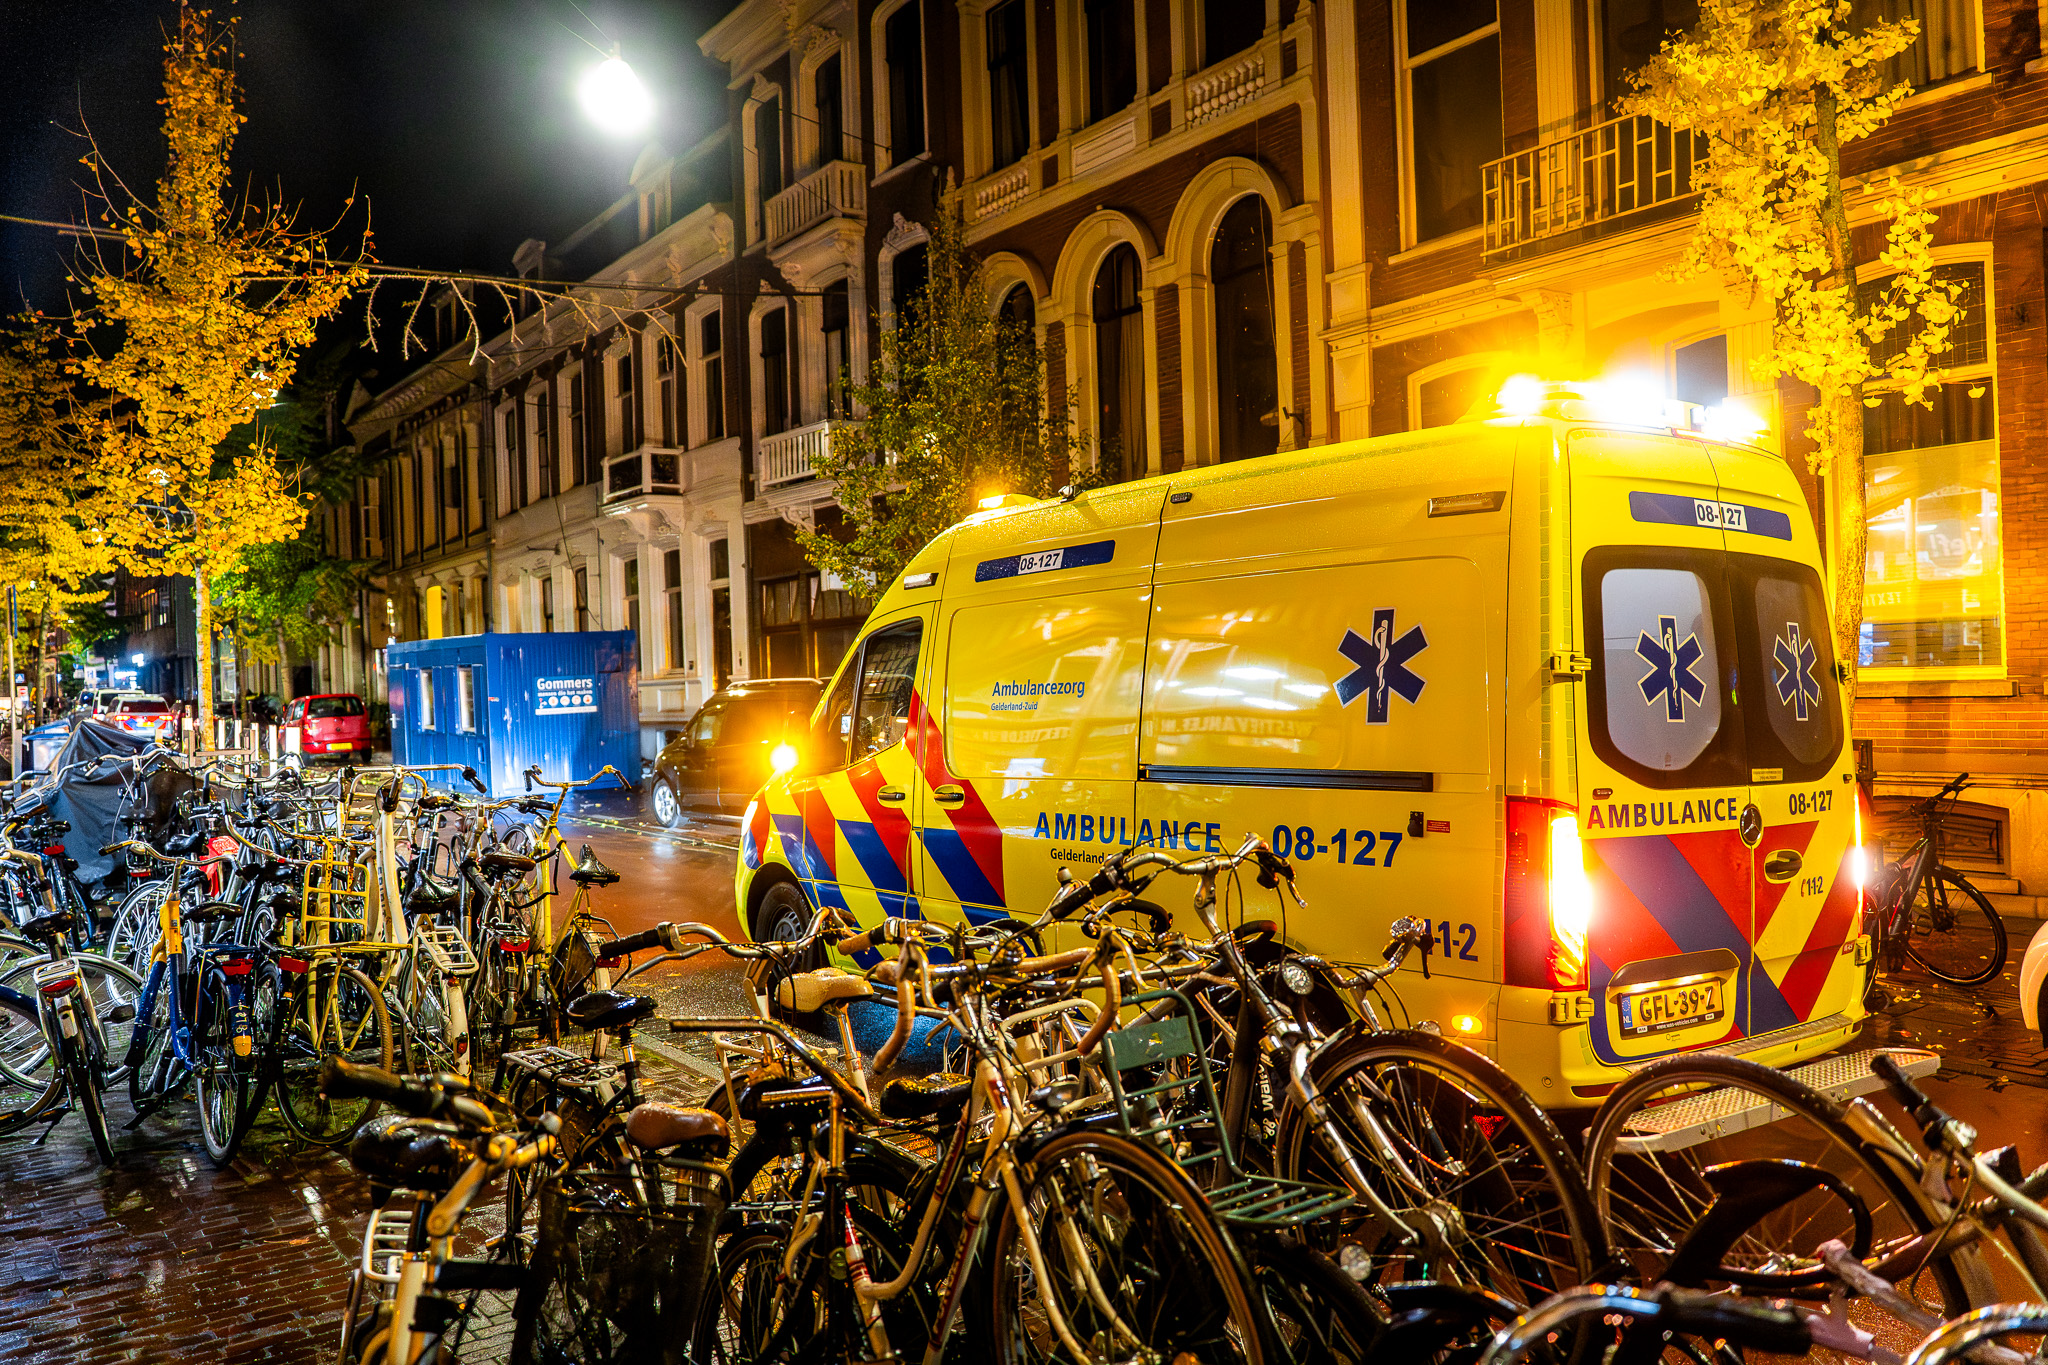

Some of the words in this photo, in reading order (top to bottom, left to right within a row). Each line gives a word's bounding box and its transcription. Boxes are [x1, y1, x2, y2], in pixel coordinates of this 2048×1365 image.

[1697, 504, 1742, 526] 08-127
[1020, 552, 1061, 571] 08-127
[537, 678, 593, 690] Gommers
[992, 679, 1085, 698] Ambulancezorg
[991, 701, 1038, 711] Gelderland-Zuid
[1789, 790, 1833, 815] 08-127
[1587, 798, 1738, 829] AMBULANCE
[1034, 812, 1221, 853] AMBULANCE
[1273, 825, 1403, 868] 08-127
[1050, 848, 1131, 866] Gelderland
[1640, 986, 1715, 1022] GFL-39-Z
[1623, 1015, 1631, 1024] NL
